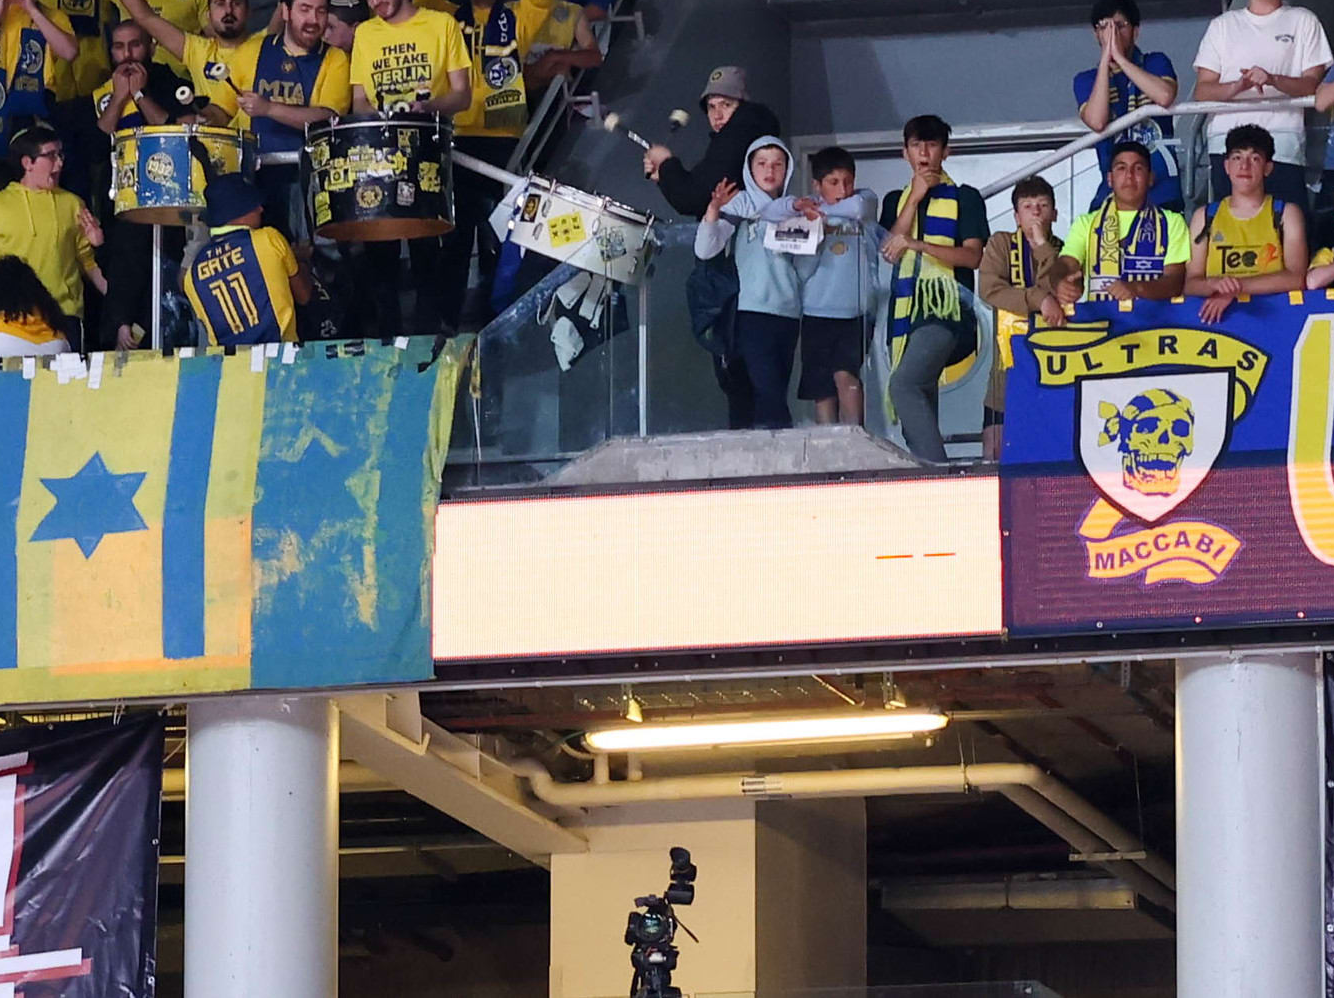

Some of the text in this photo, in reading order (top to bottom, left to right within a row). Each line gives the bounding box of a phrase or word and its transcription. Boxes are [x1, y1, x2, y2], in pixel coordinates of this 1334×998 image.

[372, 52, 429, 69] WE TAKE
[381, 43, 416, 56] THEN
[372, 64, 431, 86] BERLIN
[258, 78, 305, 107] MTA
[197, 250, 245, 281] GATE
[210, 270, 260, 335] 11
[1046, 335, 1259, 375] ULTRAS
[1094, 530, 1227, 571] MACCABI
